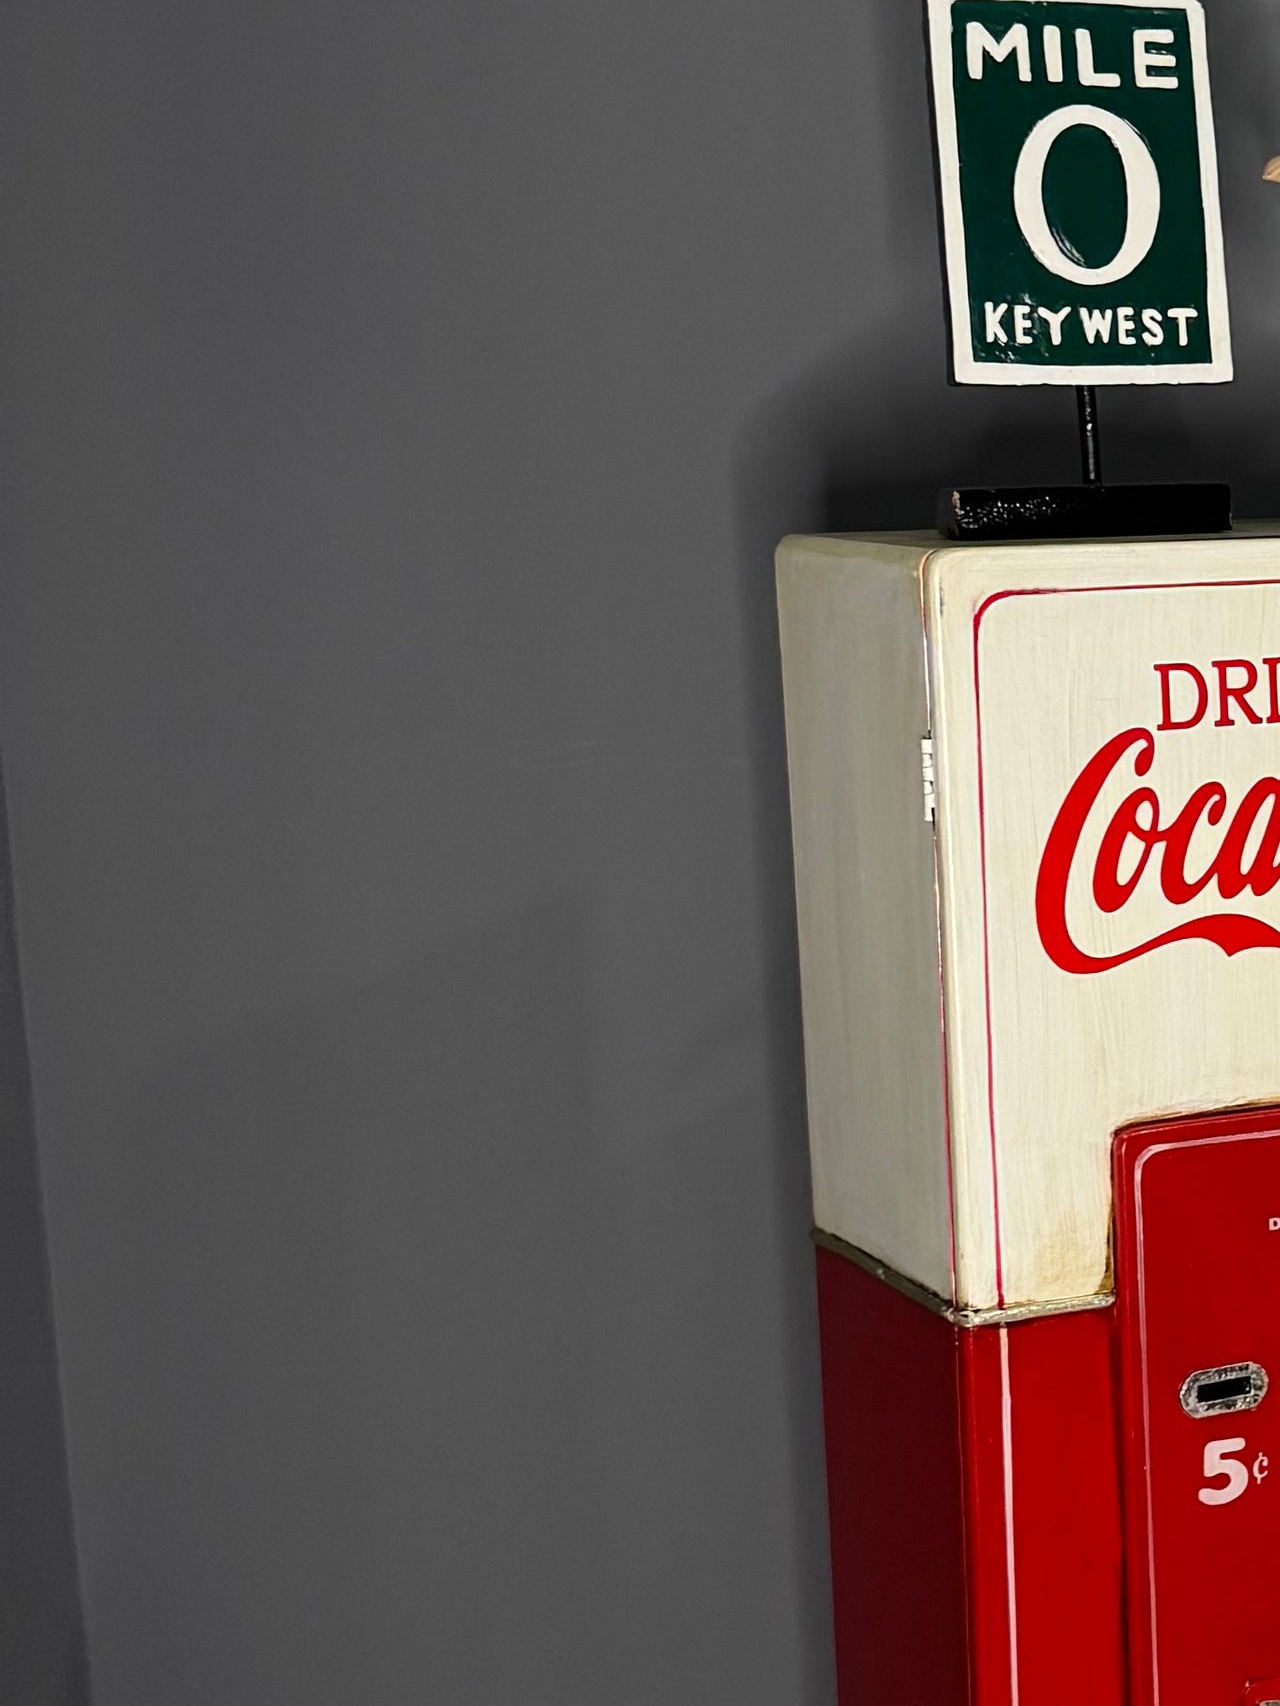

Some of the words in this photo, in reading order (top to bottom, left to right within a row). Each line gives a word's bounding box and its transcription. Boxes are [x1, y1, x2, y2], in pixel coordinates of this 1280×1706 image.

[965, 21, 1179, 90] MILE
[984, 301, 1072, 347] KEY
[1080, 306, 1198, 347] WEST
[1197, 1437, 1270, 1507] 5¢
